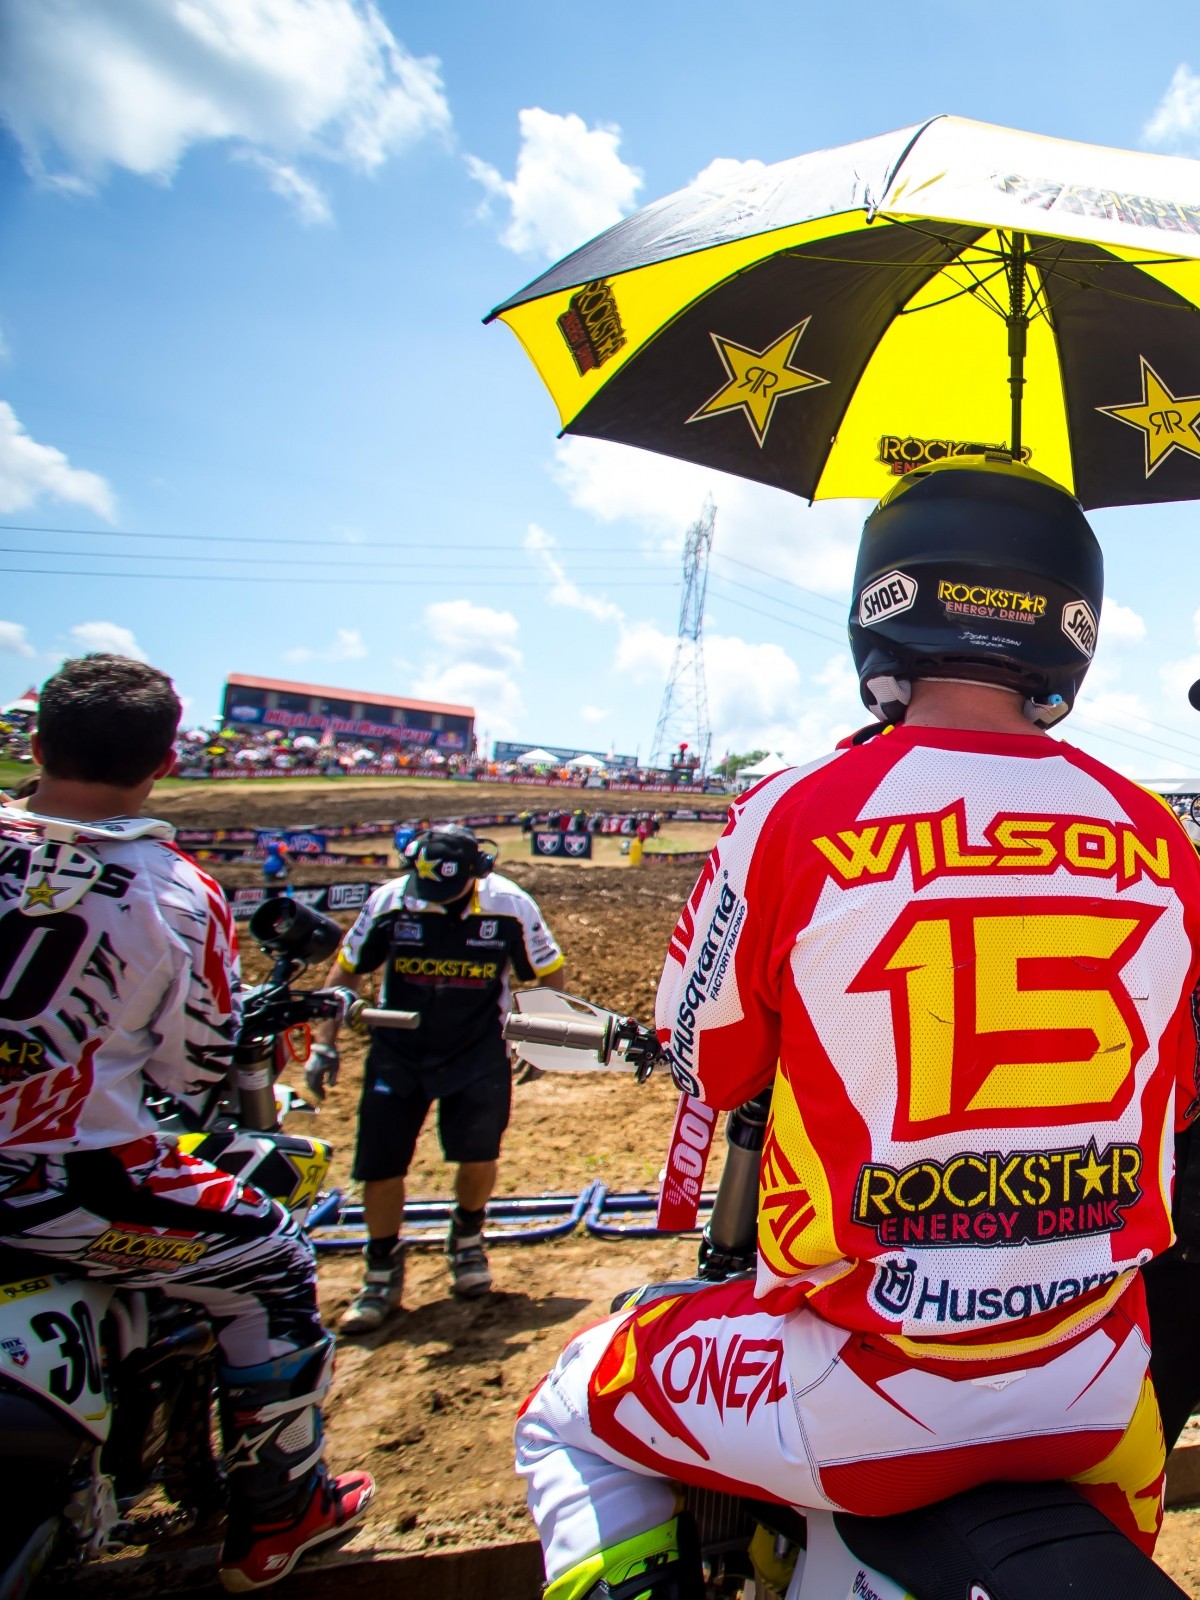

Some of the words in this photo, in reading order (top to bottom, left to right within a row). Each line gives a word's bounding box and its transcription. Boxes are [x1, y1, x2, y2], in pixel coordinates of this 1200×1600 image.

[863, 580, 909, 619] SHOEI
[939, 582, 1047, 614] ROCKSTAR
[947, 601, 996, 616] ENERGY
[1000, 609, 1035, 623] DRINK
[812, 812, 1171, 881] WILSON
[673, 880, 737, 1069] Husqvarna
[710, 945, 731, 1001] FACTORY
[727, 904, 747, 950] RACING
[884, 914, 1141, 1122] 15
[858, 1148, 1142, 1217] ROCKSTAR
[881, 1212, 1019, 1241] ENERGY
[1037, 1200, 1119, 1236] DRINK
